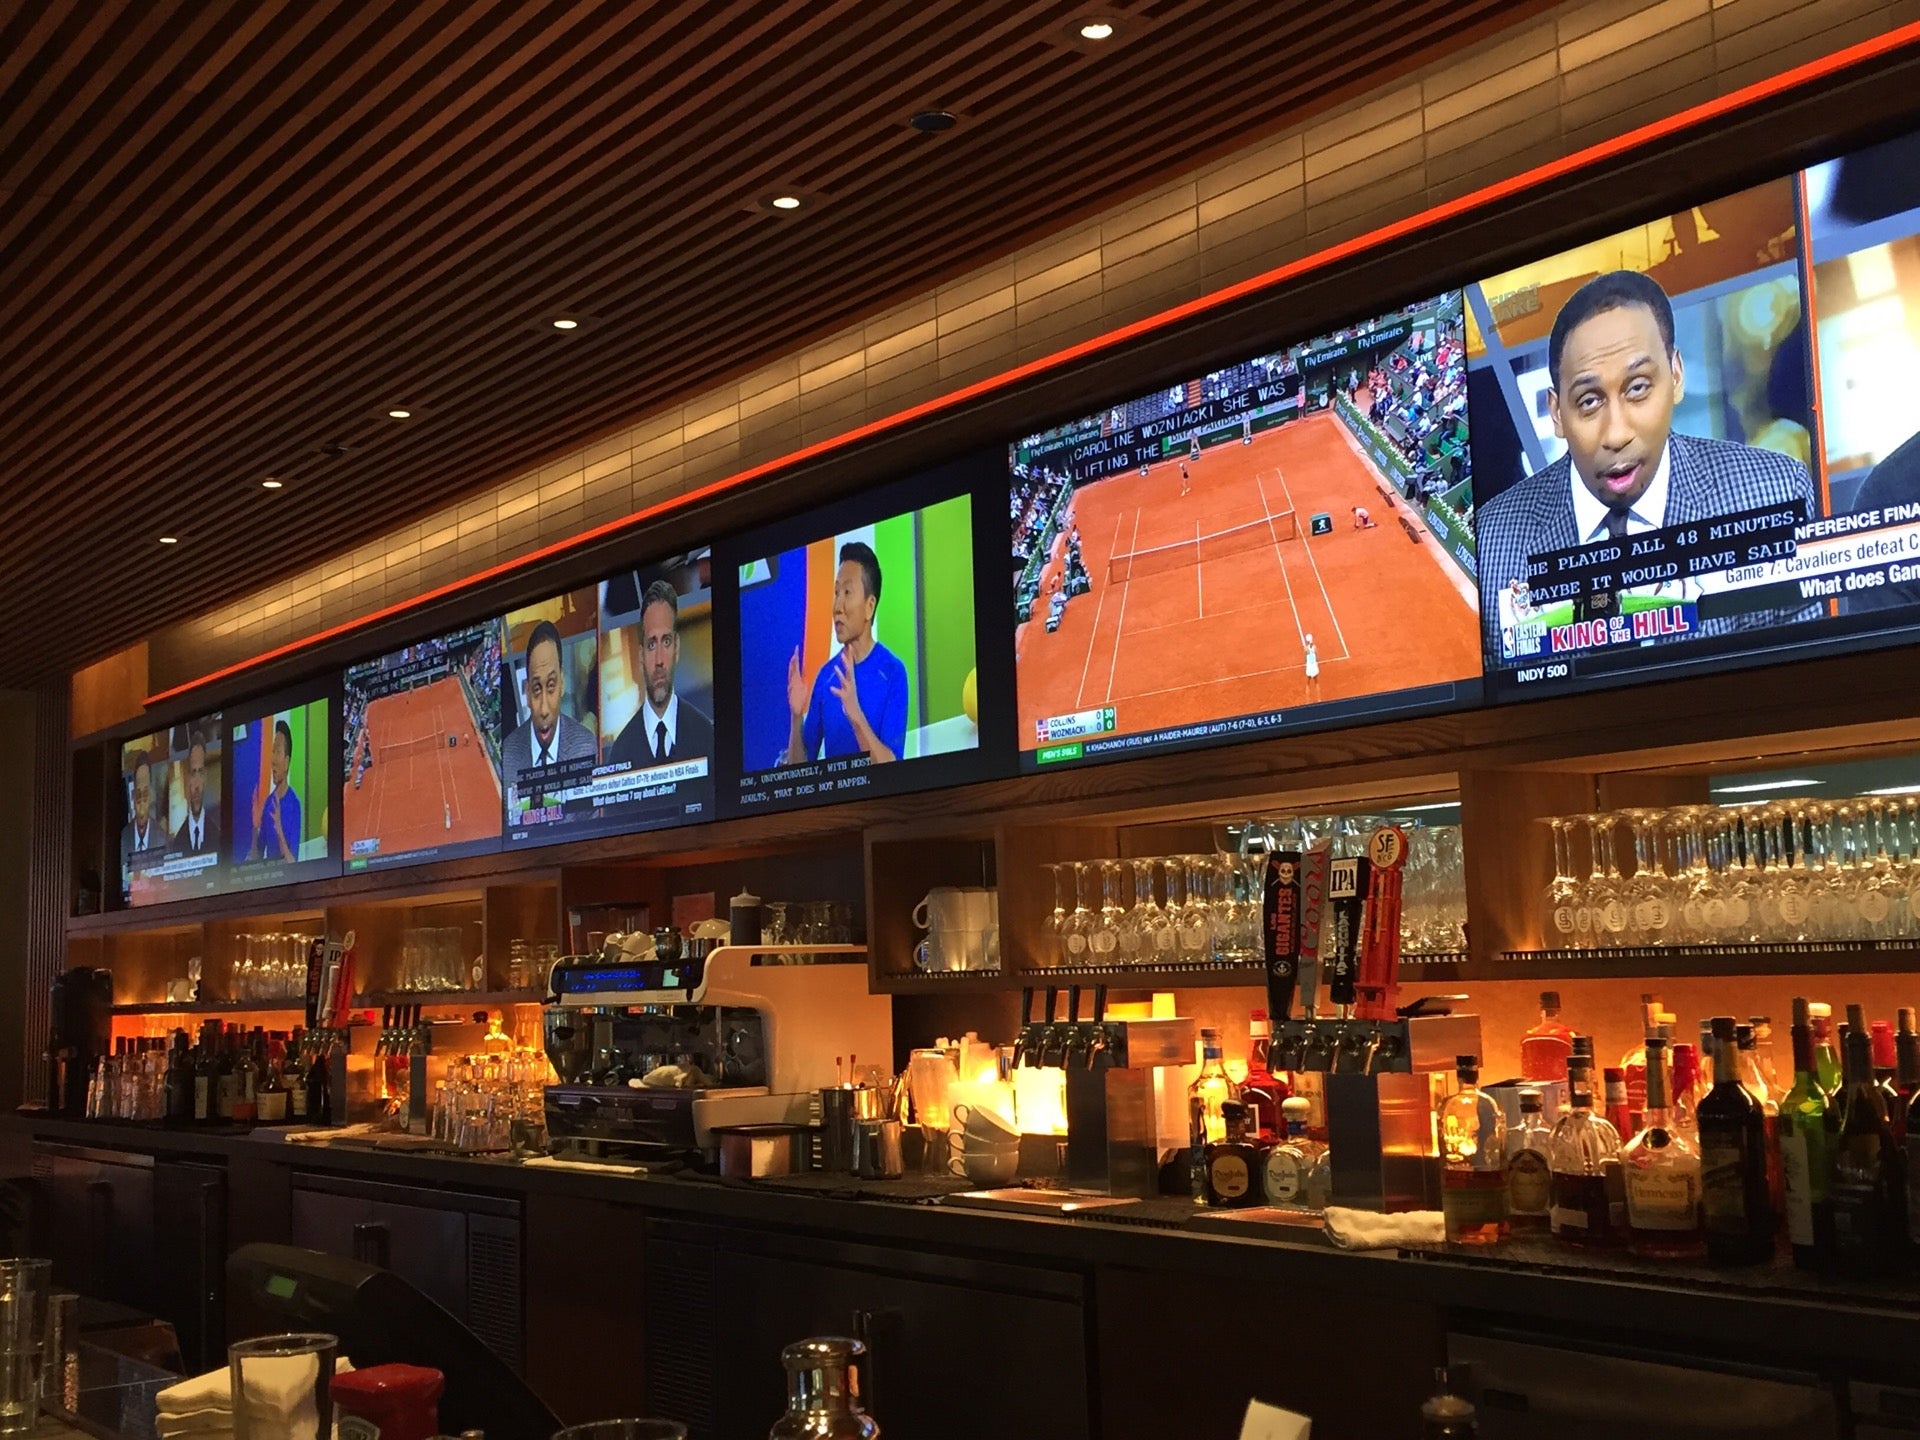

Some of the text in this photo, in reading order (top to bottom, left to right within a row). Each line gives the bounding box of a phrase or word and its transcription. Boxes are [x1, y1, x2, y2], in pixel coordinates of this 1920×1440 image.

[1074, 382, 1286, 461] CAROLINE WOZNIACKI SHE WAS
[1075, 443, 1160, 481] LIFTING THE
[1528, 511, 1804, 577] HE PLAYED ALL 48 MINUTES.
[1529, 539, 1797, 603] MAYBE IT WOULD HAVE SAID
[1726, 562, 1764, 584] Game
[1785, 546, 1851, 573] Cavaliers
[1857, 536, 1904, 560] defeat
[1800, 576, 1843, 599] What
[1845, 569, 1886, 591] does
[1551, 605, 1689, 652] KING OF THE HILL
[1517, 664, 1568, 683] INDY 500
[1050, 716, 1076, 728] COLLINS
[1050, 725, 1086, 739] WOZNIACKI
[827, 761, 847, 772] WITH
[1376, 834, 1394, 853] SF
[1331, 868, 1355, 892] IPA
[1276, 887, 1292, 955] GIGANTES
[330, 949, 341, 961] IP
[1635, 1184, 1686, 1201] Hennessy
